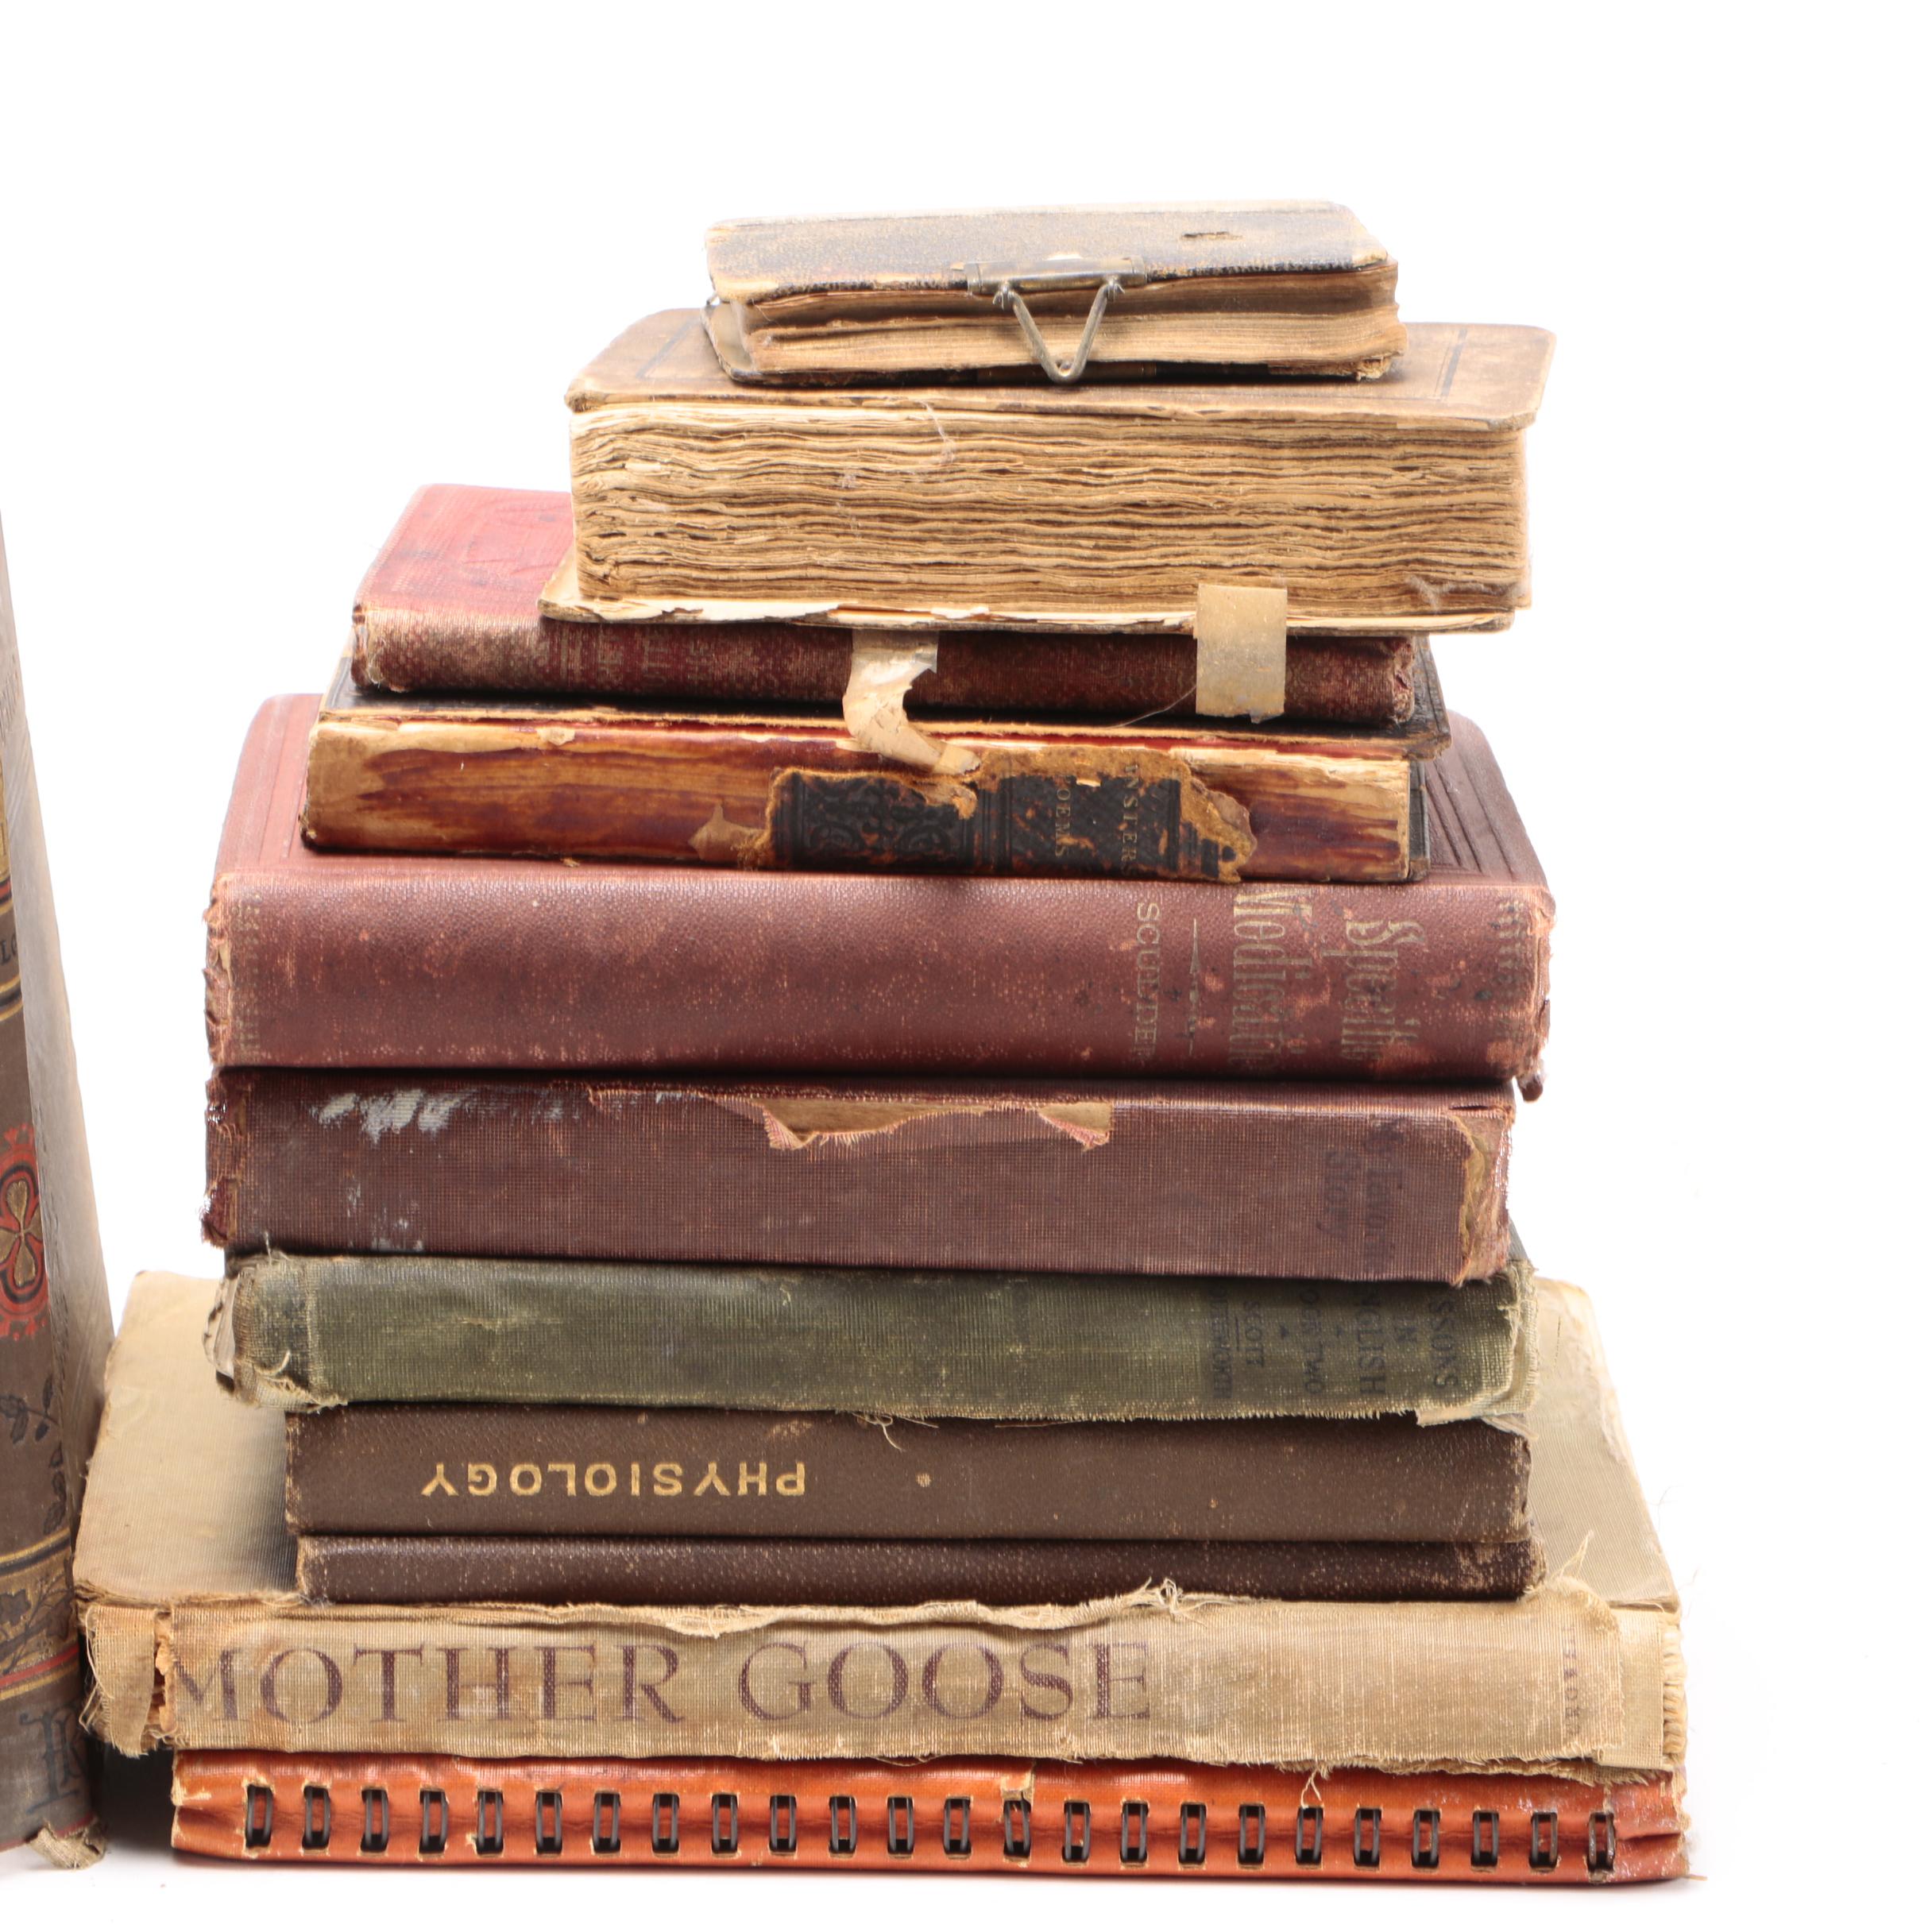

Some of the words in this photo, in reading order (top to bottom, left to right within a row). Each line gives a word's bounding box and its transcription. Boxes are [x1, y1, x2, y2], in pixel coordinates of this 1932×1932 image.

[1243, 1300, 1265, 1367] SCOTT
[1353, 1288, 1387, 1395] NGLISH
[419, 1462, 806, 1497] PHYSIOLOGY
[175, 1642, 686, 1725] MOTHER
[738, 1640, 1151, 1723] GOOSE
